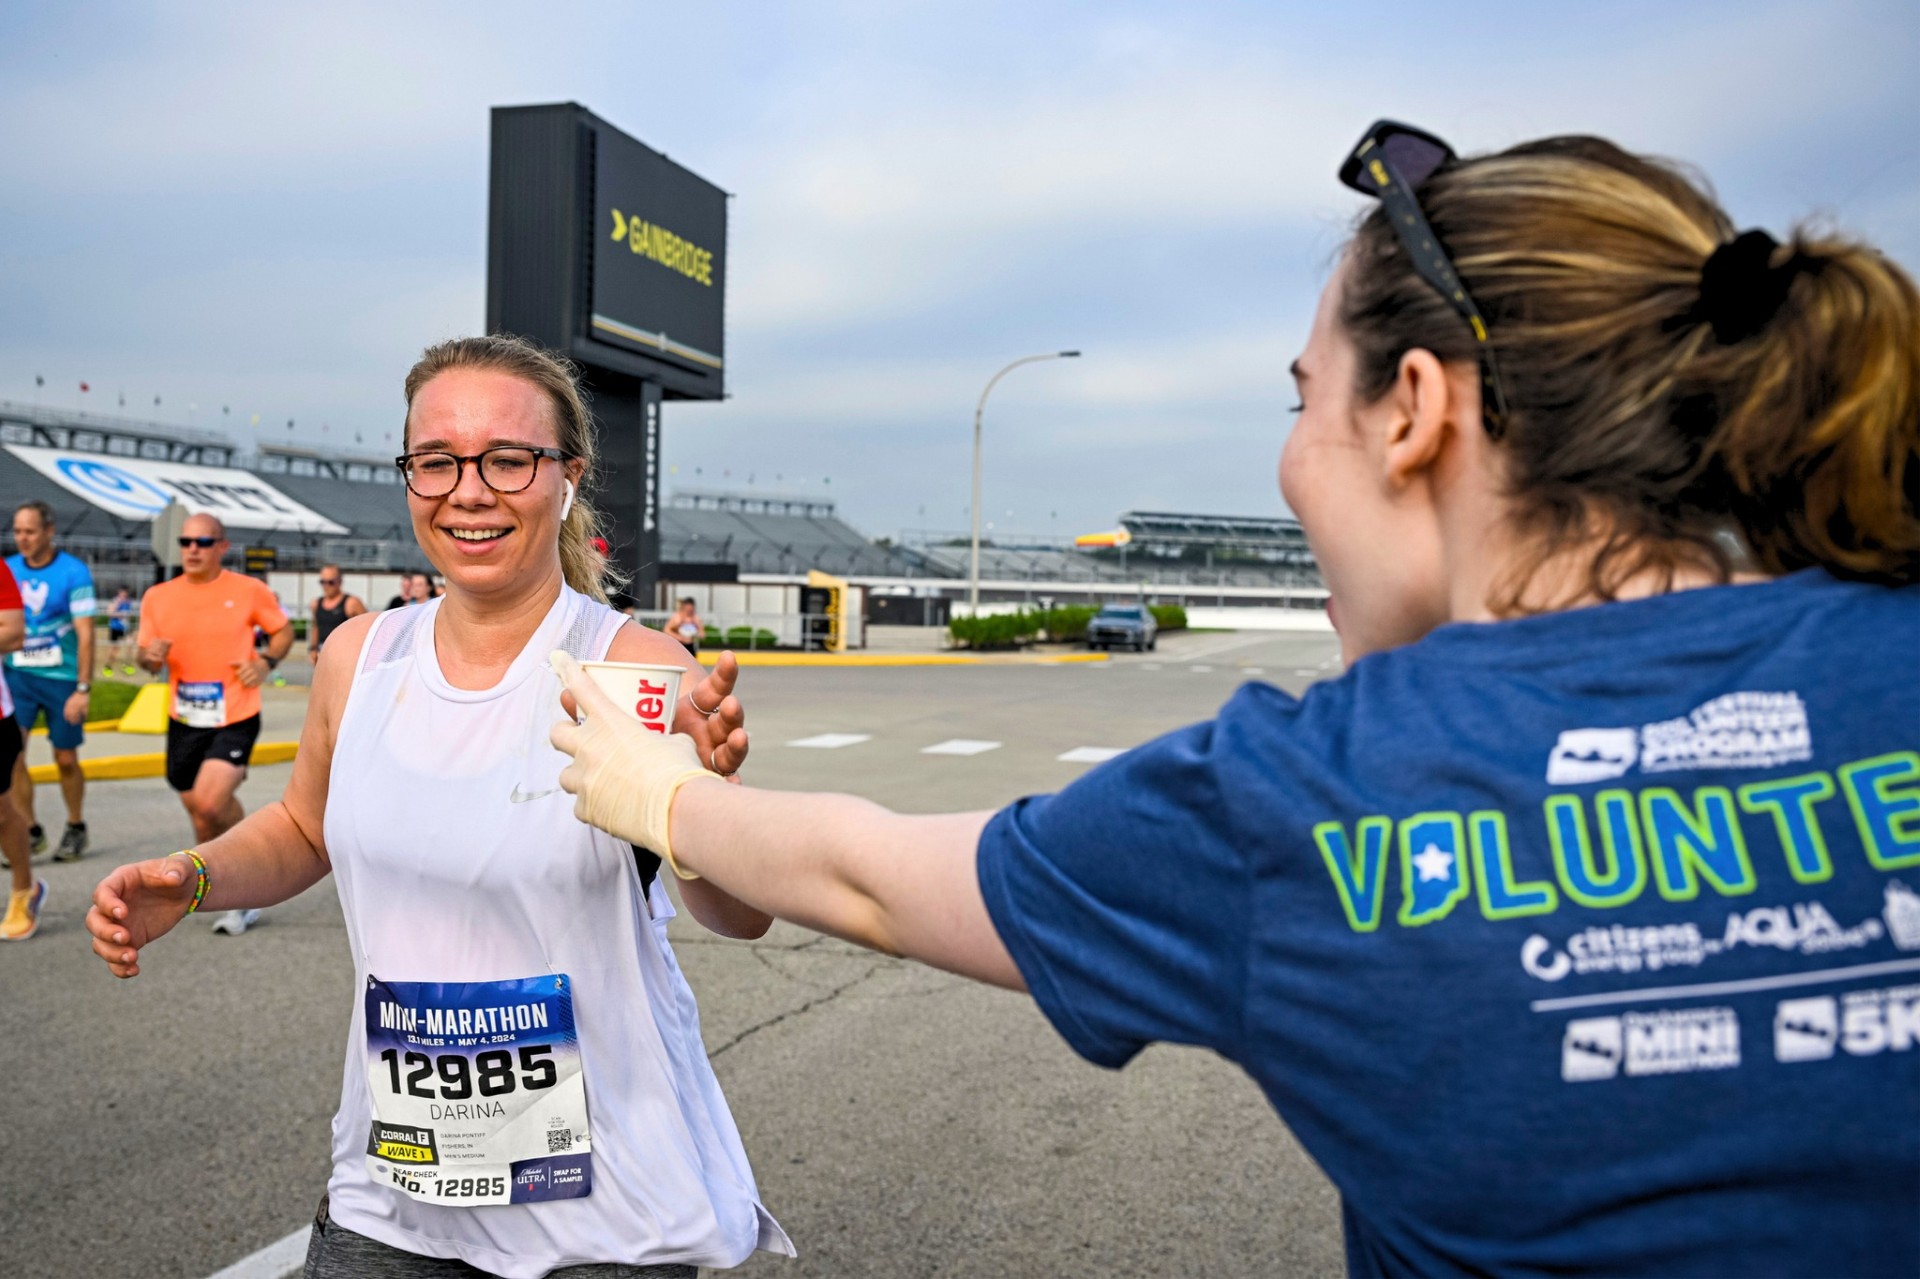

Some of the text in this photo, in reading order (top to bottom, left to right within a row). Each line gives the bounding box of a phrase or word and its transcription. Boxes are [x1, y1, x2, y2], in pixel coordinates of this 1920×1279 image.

[629, 215, 713, 287] GAINBRIDGE
[1724, 901, 1842, 951] AQUA
[379, 1001, 548, 1035] MINI-MARATHON
[421, 1038, 445, 1047] MILES
[458, 1038, 477, 1047] MAY
[480, 1036, 490, 1045] 4,
[491, 1034, 516, 1043] 2024
[381, 1045, 557, 1100] 12985
[430, 1101, 506, 1120] DARINA
[381, 1129, 416, 1144] CORRAL
[387, 1145, 418, 1159] WAVE
[413, 1170, 438, 1178] CHECK
[517, 1174, 546, 1184] ULTRA
[553, 1167, 582, 1177] SWAP FOR
[393, 1172, 505, 1197] No. 12985
